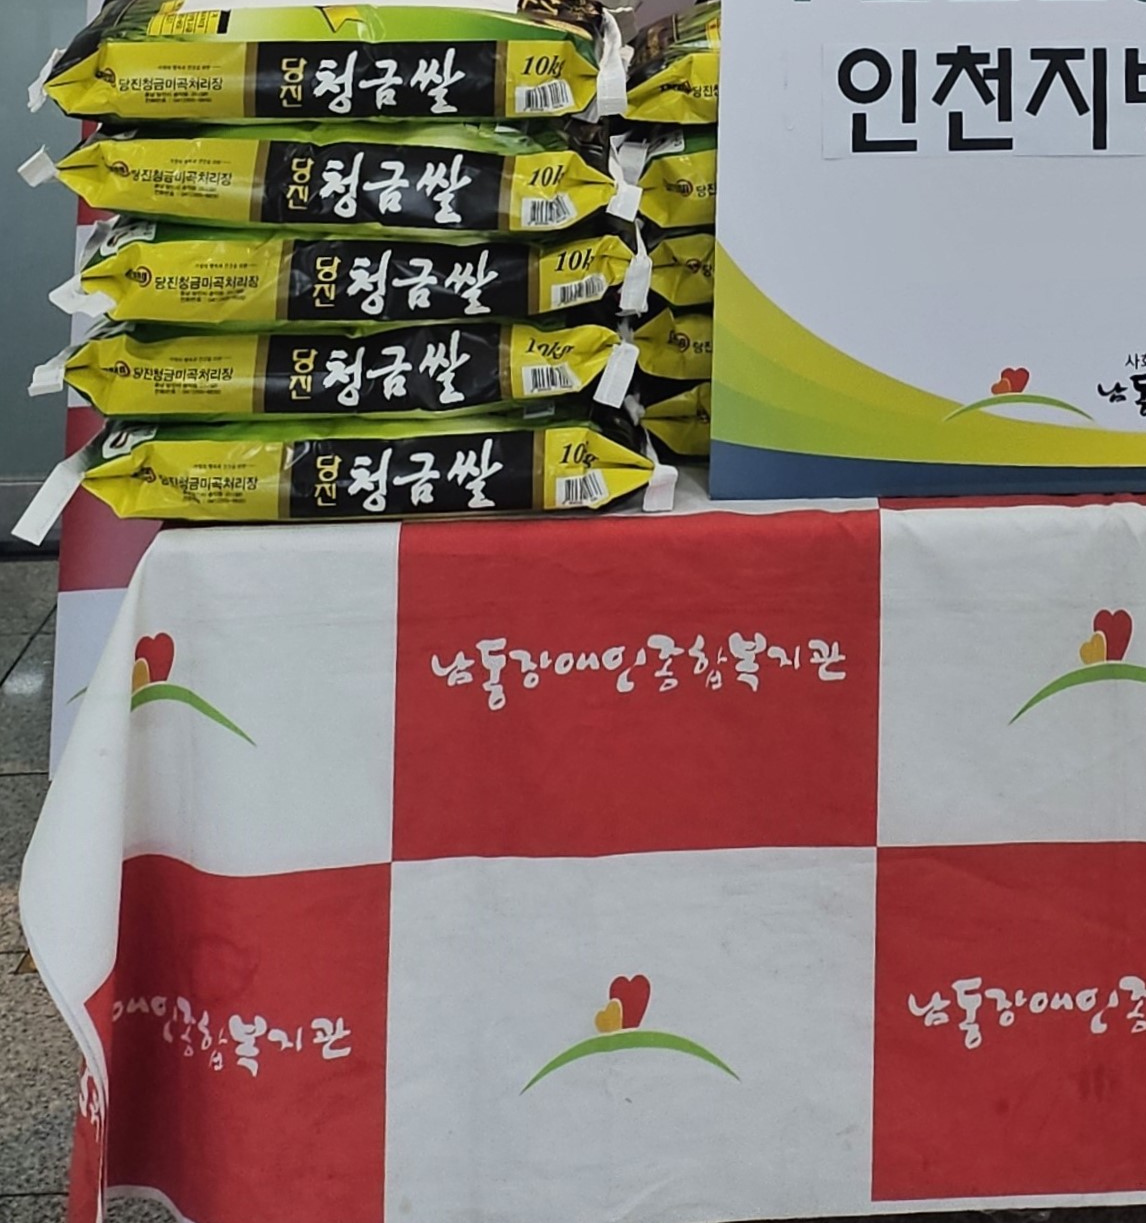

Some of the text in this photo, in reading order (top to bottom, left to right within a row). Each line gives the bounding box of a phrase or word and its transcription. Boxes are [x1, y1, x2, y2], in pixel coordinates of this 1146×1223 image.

[118, 77, 223, 92] 당진청금미곡처리장
[313, 47, 466, 114] 청금쌀
[319, 151, 472, 224] 청금쌀
[347, 249, 499, 315] 청금쌀
[322, 329, 471, 406] 청금쌀
[348, 438, 503, 512] 청금쌀
[559, 440, 600, 468] 10g
[430, 631, 848, 710] 남동장애인종합복지관
